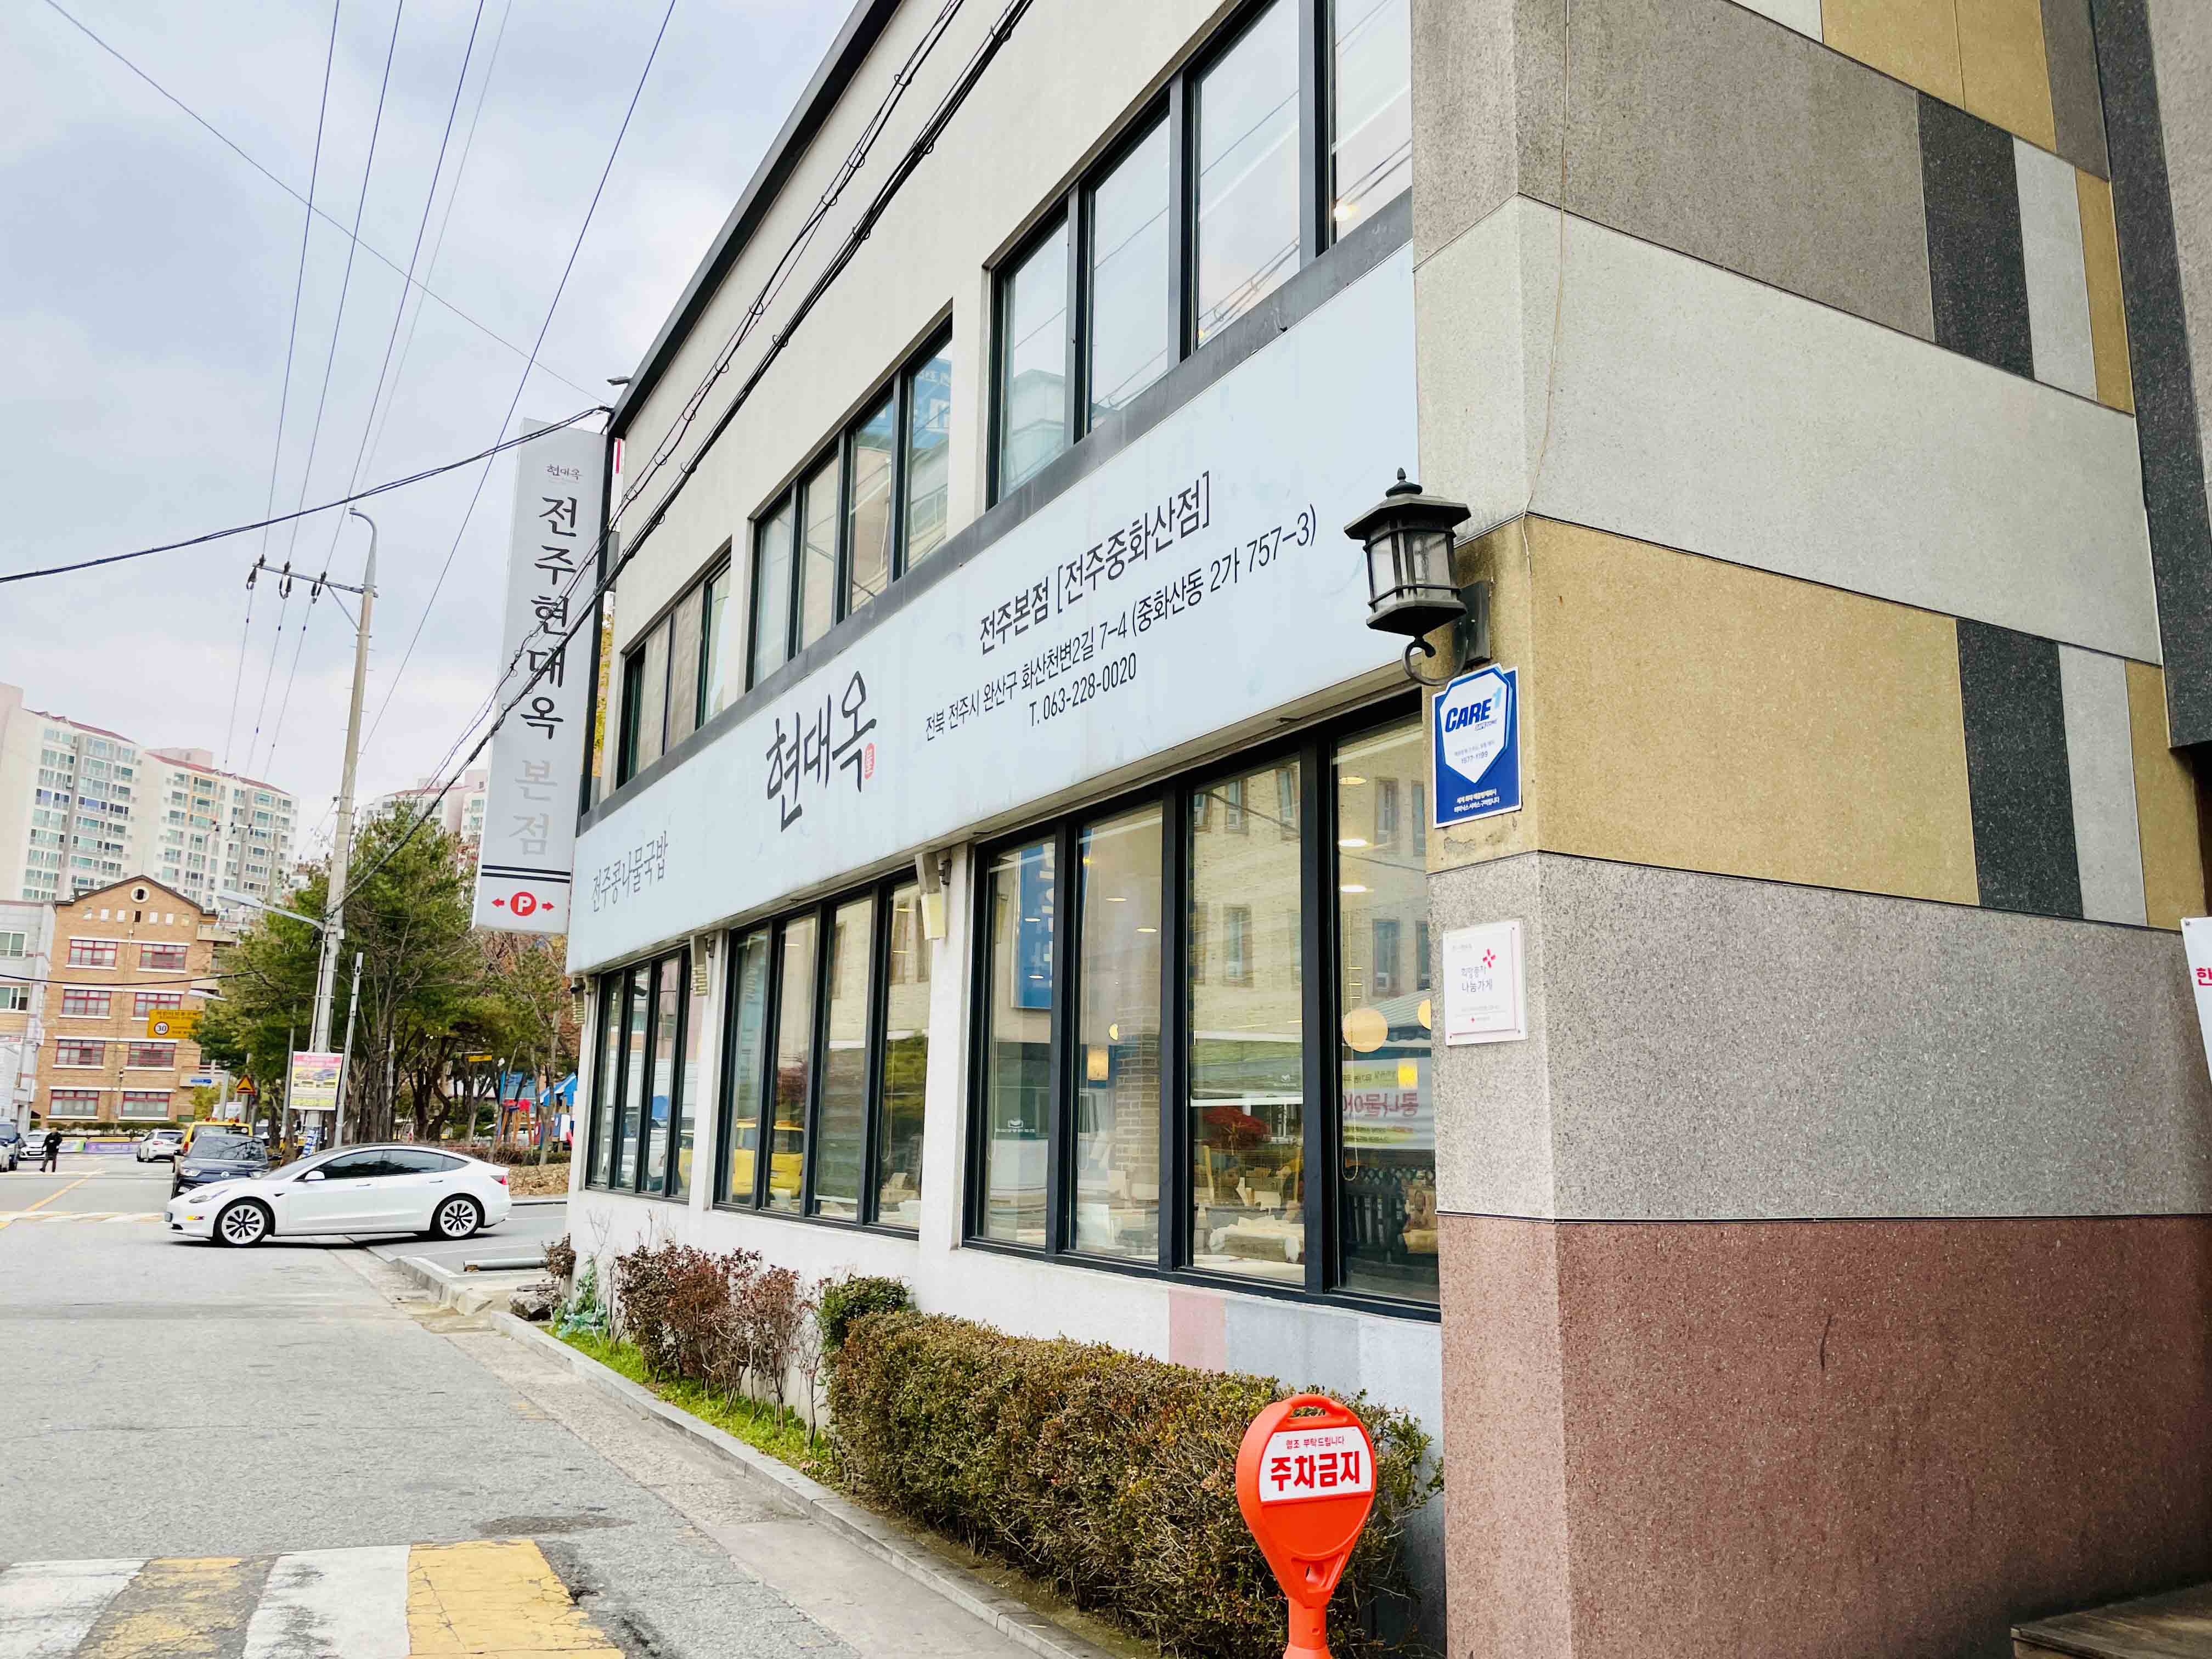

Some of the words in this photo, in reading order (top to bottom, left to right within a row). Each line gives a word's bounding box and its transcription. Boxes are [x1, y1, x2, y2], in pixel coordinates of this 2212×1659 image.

[980, 576, 1048, 655] 전주본점
[1057, 470, 1210, 614] [전주중화산점]
[521, 497, 577, 739] 전주현대옥
[926, 710, 945, 741] 전북
[949, 689, 979, 723] 전주시
[984, 671, 1017, 712] 완산구
[1022, 626, 1093, 690] 화산천변2길
[1099, 611, 1127, 650] 7-4
[1132, 568, 1204, 636] (중화산동
[1210, 547, 1240, 592] 2가
[1246, 504, 1316, 573] 757-3)
[1029, 701, 1040, 727] T.
[1043, 652, 1136, 720] 063-228-0020
[766, 671, 877, 832] 현대옥
[509, 760, 557, 855] 본점
[591, 830, 669, 912] 전주콩나물국밥
[1271, 1451, 1360, 1491] 주차금지
[1286, 1439, 1300, 1449] 협조
[1304, 1435, 1344, 1447] 부탁드립니다
